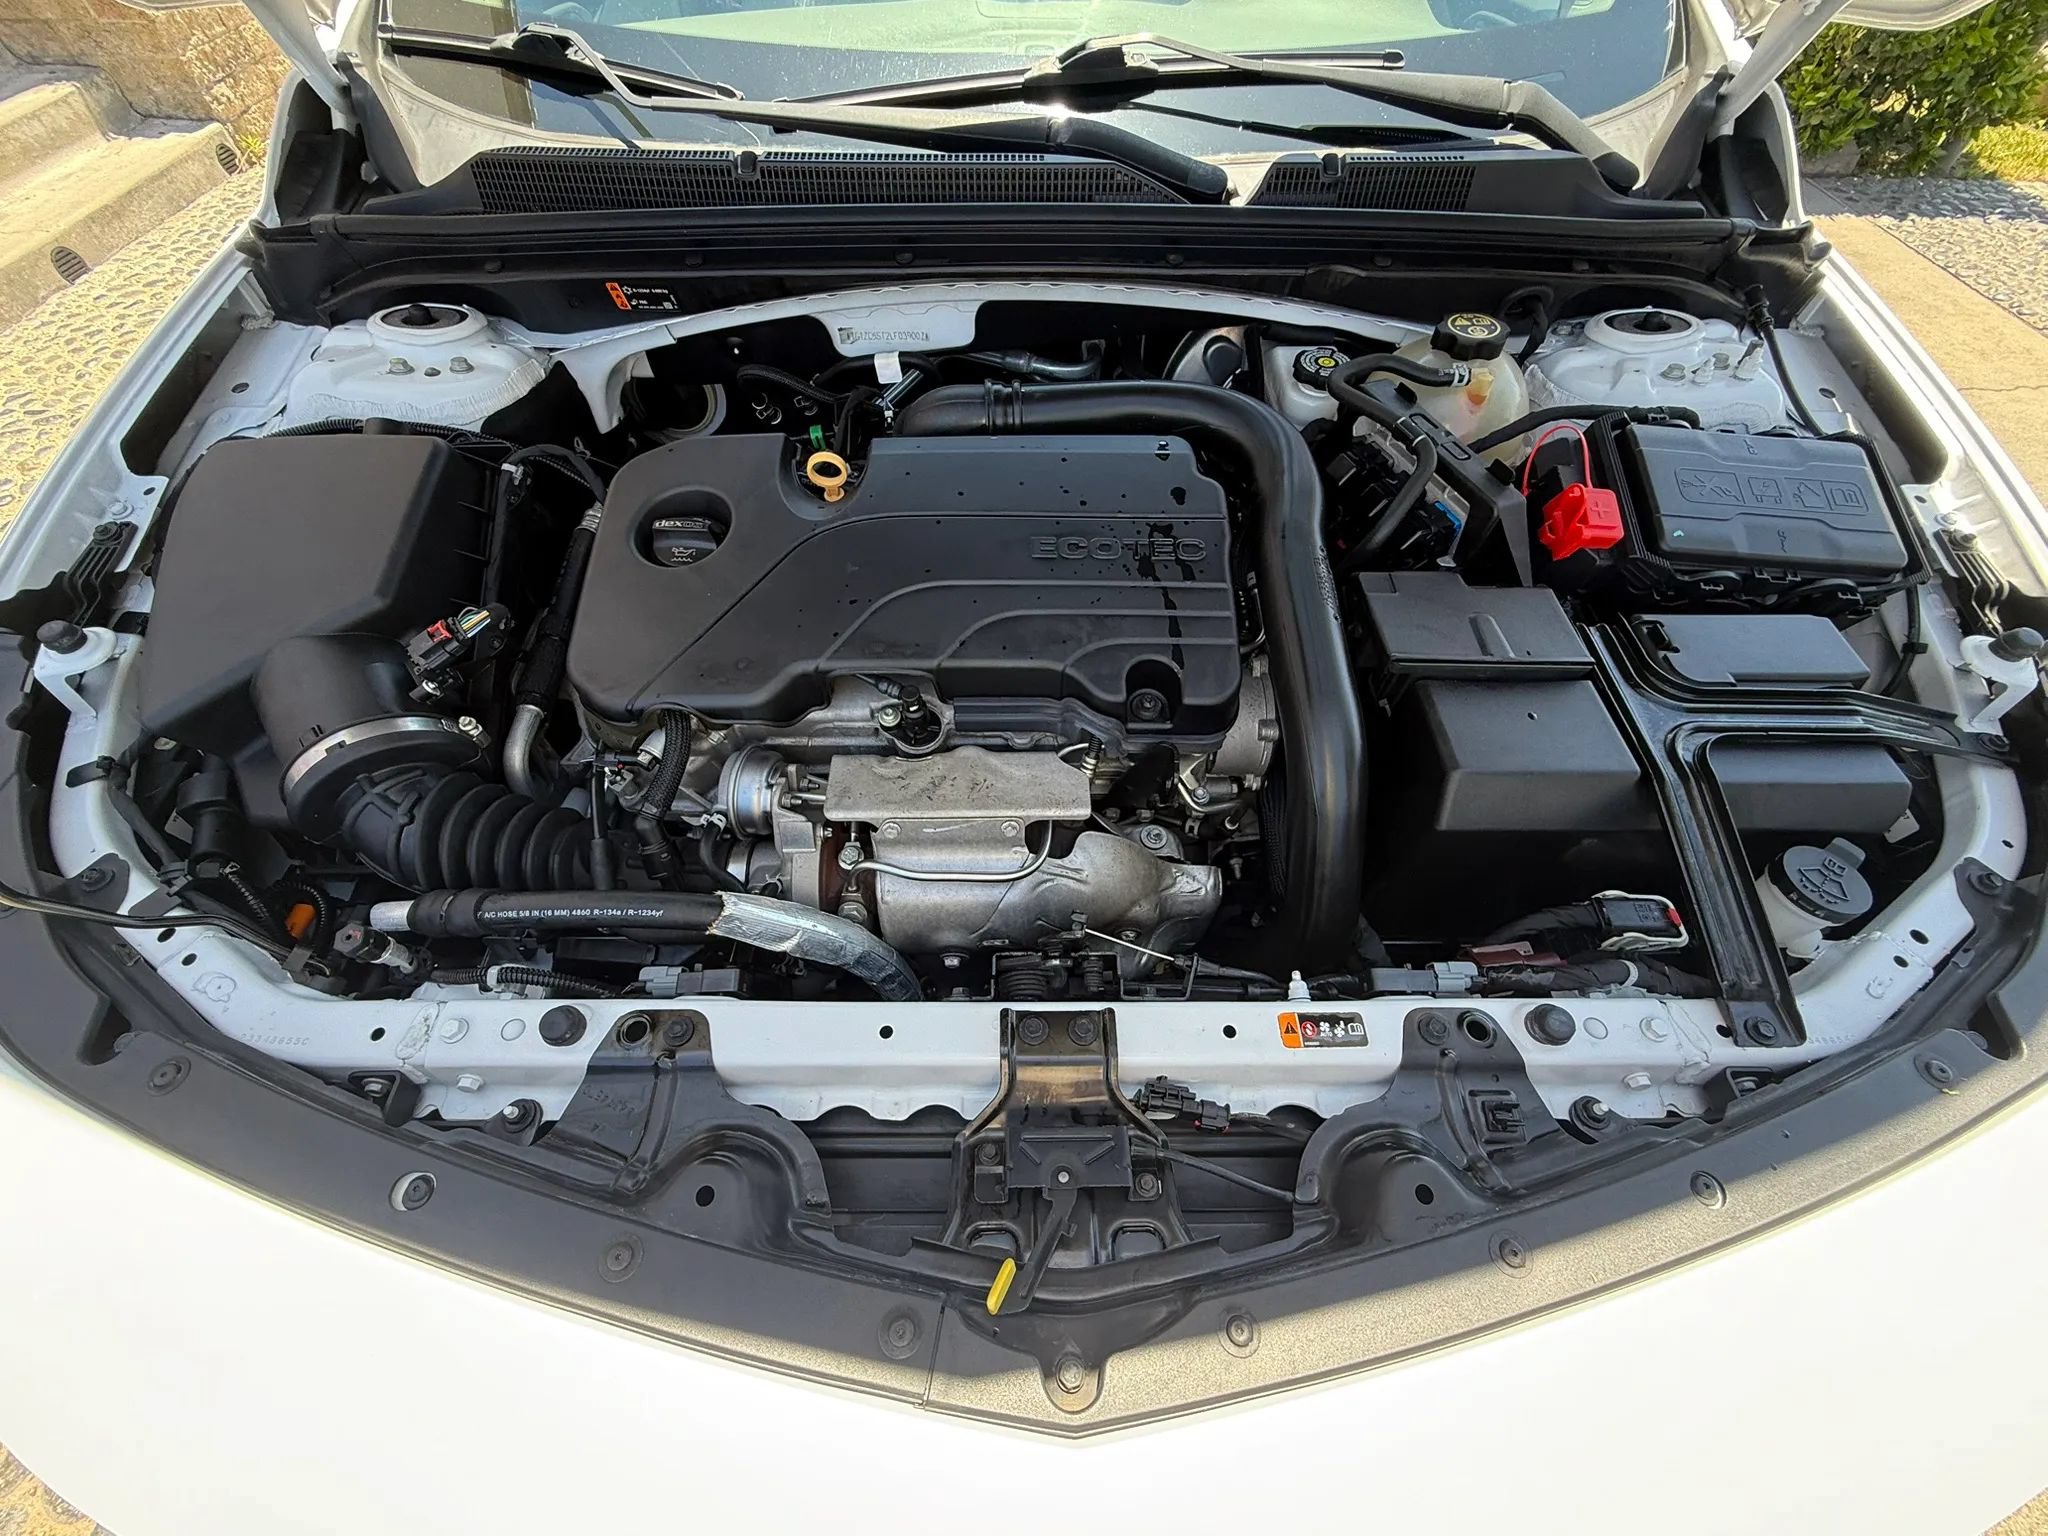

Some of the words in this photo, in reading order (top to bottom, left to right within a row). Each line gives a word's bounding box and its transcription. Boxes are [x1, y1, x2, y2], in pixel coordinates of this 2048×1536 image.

[655, 520, 704, 529] dexos
[1031, 536, 1206, 561] ECOTEC
[497, 910, 518, 918] HOSE
[541, 909, 552, 917] (16
[553, 909, 570, 917] MM)
[593, 908, 622, 916] R-134a
[627, 909, 664, 918] R-1234yf
